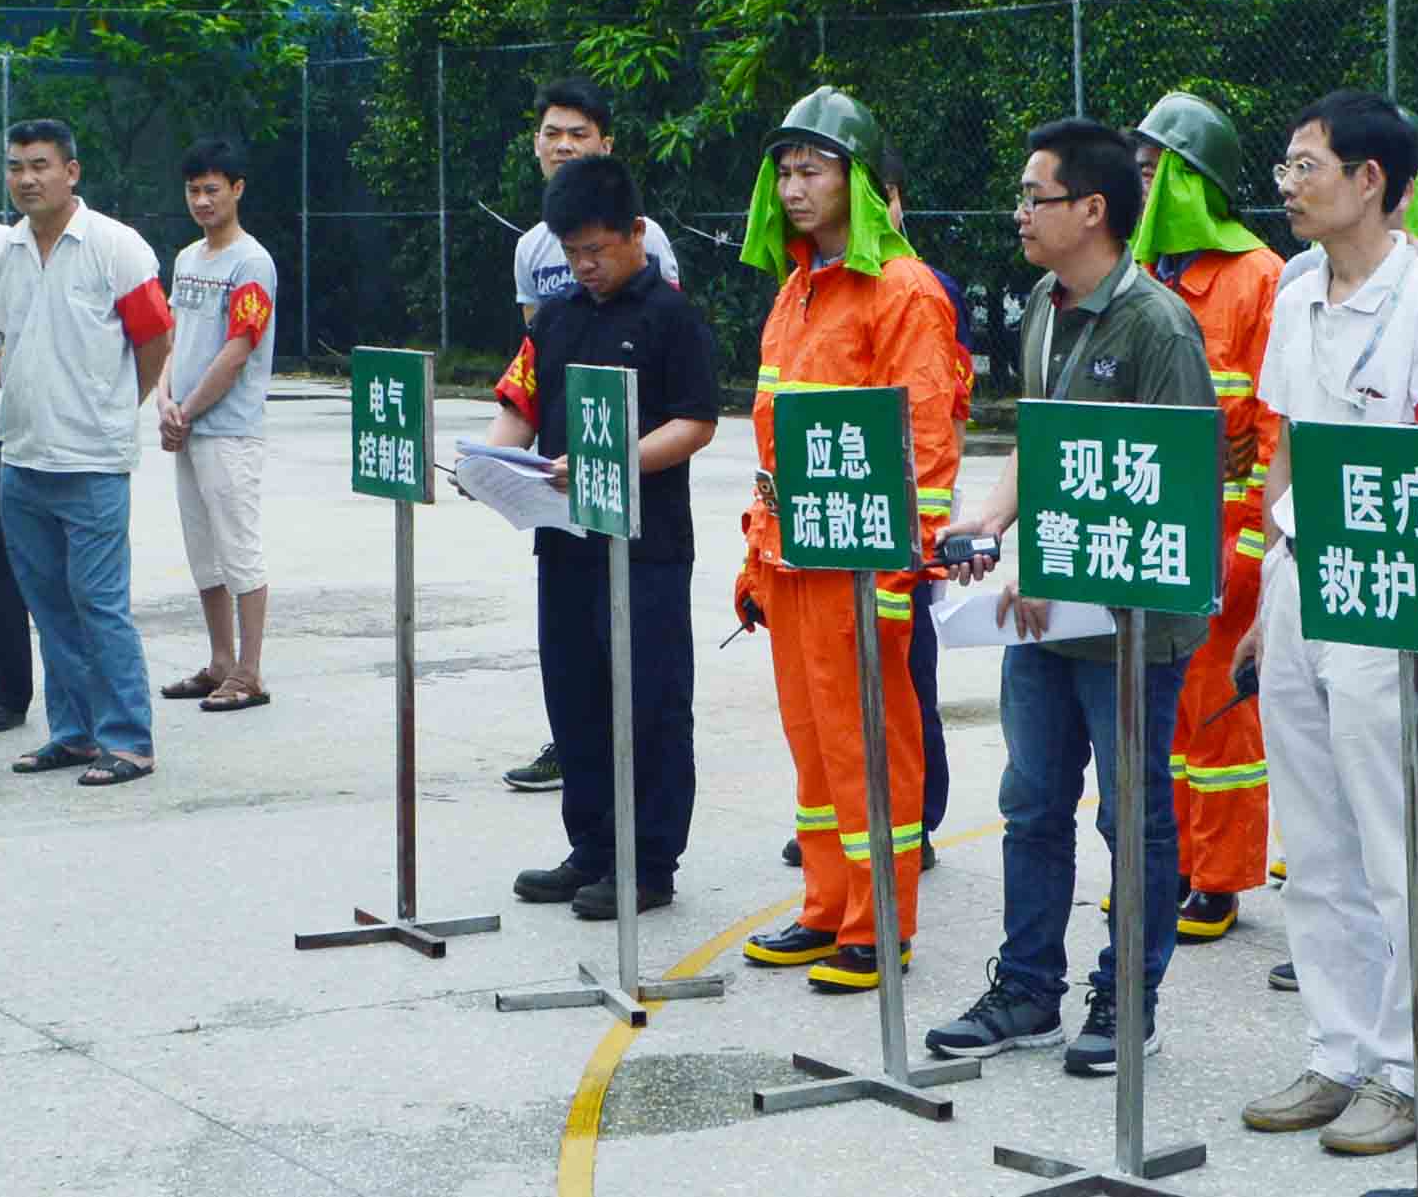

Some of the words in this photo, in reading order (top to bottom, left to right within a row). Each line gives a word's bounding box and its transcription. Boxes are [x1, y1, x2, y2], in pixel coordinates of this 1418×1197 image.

[368, 375, 407, 428] 电气
[581, 397, 613, 448] 灭火
[359, 431, 416, 485] 控制组
[805, 421, 871, 479] 应急
[1060, 439, 1161, 505] 现场
[575, 455, 623, 513] 作战组
[791, 491, 895, 549] 疏散组
[1036, 510, 1191, 585] 警戒组
